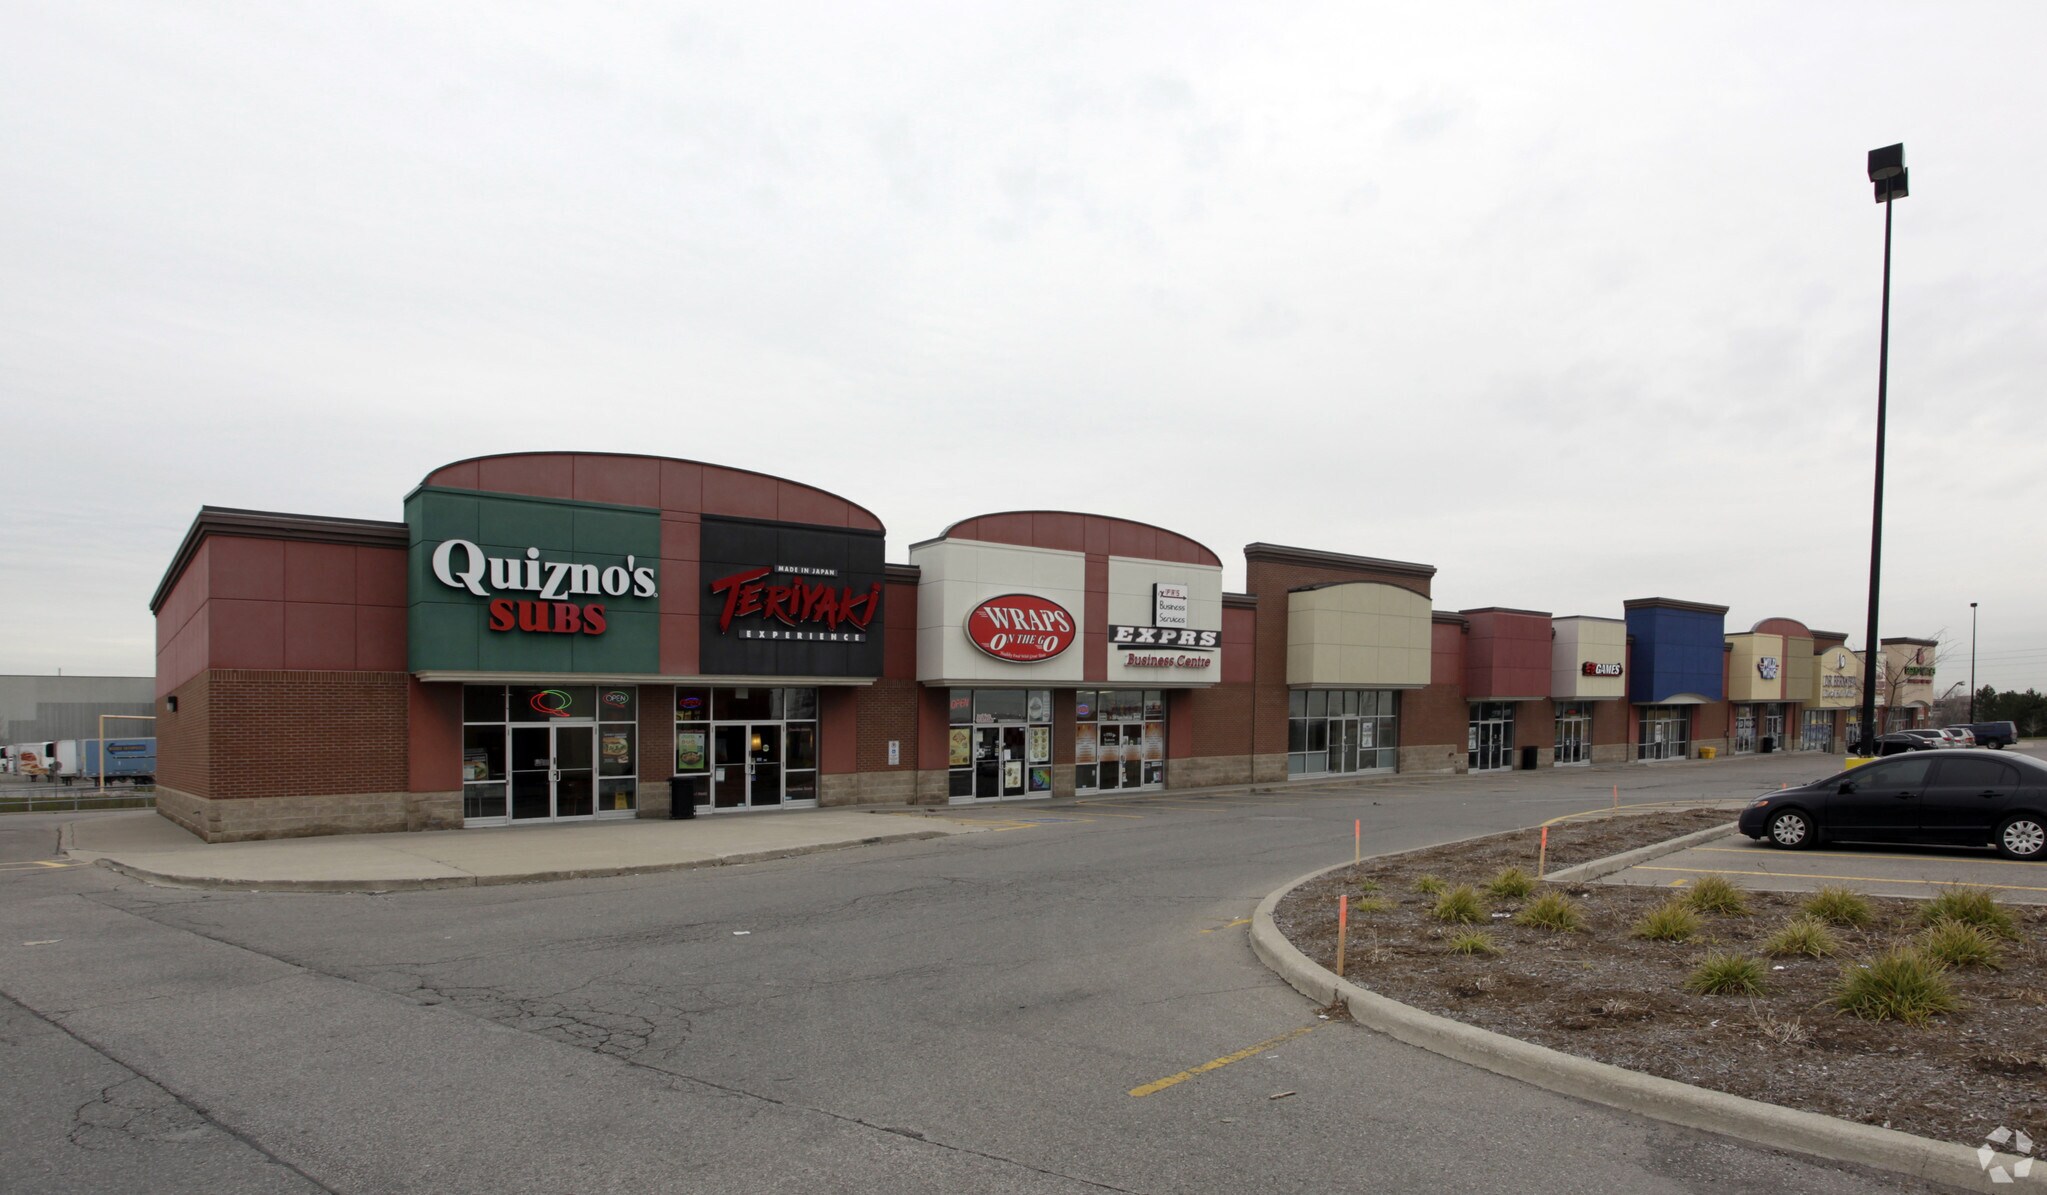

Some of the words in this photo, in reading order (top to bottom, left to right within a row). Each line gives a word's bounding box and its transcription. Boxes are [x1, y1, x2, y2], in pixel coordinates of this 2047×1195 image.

[432, 539, 656, 600] Quizno's
[778, 565, 798, 573] MADE
[811, 568, 835, 576] JAPAN
[1159, 600, 1185, 611] Business
[983, 606, 1070, 632] WRAPS
[1159, 613, 1185, 623] Services
[746, 630, 860, 641] EXPERIENCE
[1114, 626, 1217, 646] EXPRS
[990, 633, 1015, 650] ON
[1016, 634, 1036, 644] THE
[1037, 635, 1058, 652] GO
[1125, 653, 1174, 667] Business
[1176, 655, 1211, 668] Centre
[1596, 664, 1620, 675] GAMES
[605, 694, 626, 702] OPEN
